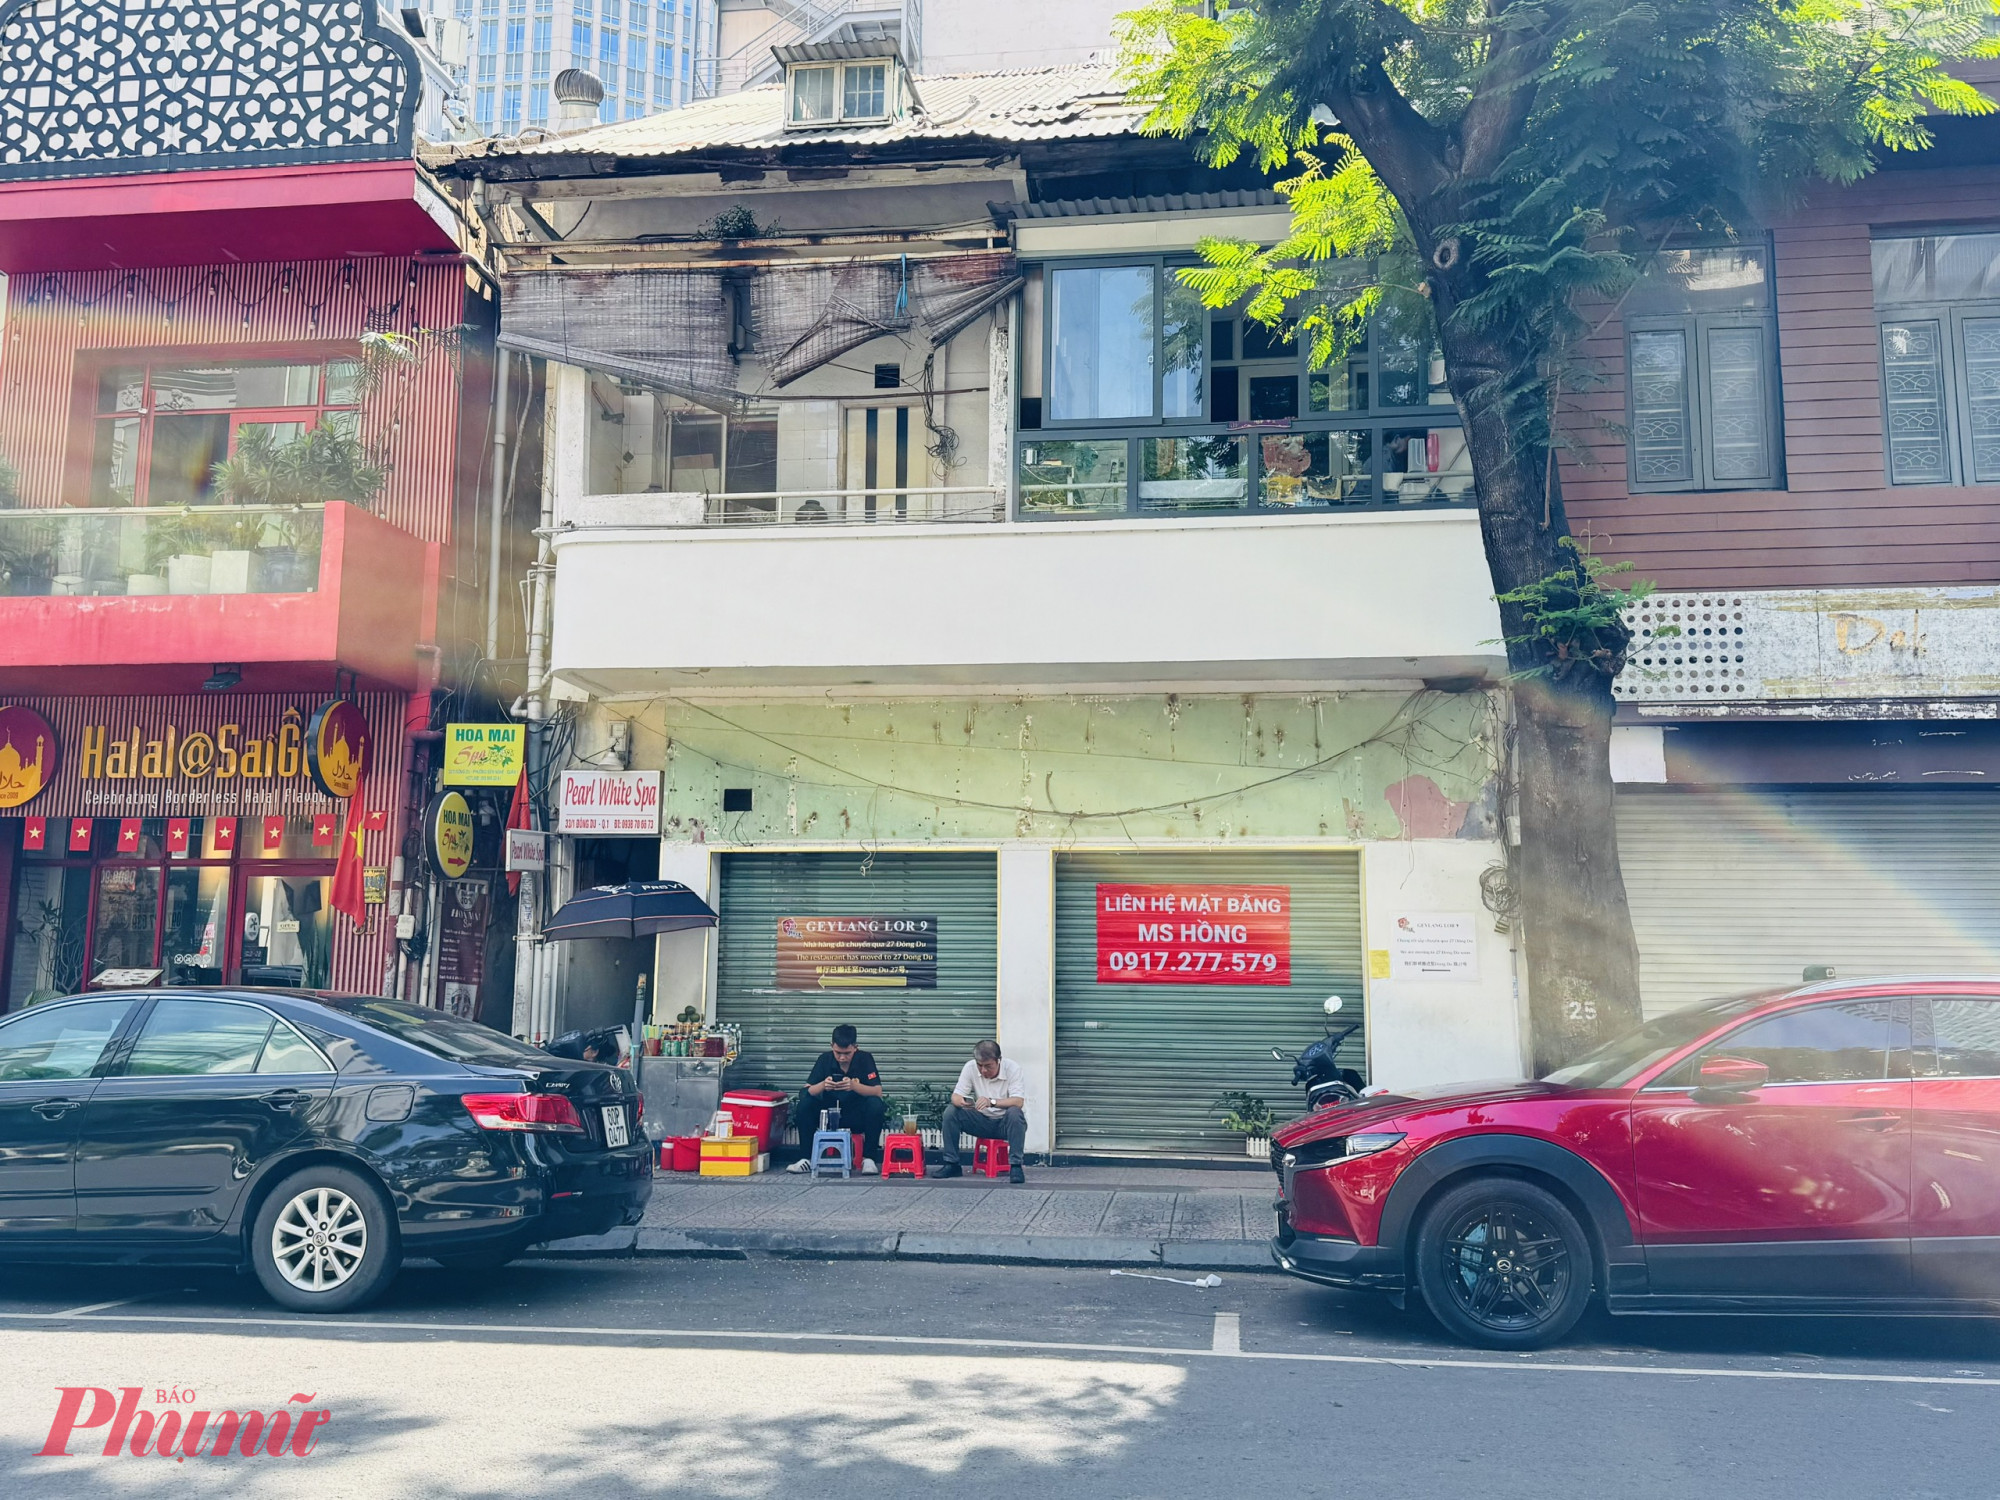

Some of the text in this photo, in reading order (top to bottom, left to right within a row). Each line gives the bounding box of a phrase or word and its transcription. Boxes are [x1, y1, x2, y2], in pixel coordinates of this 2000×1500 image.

[456, 729, 515, 742] HOA MAI
[453, 745, 486, 766] Spa
[85, 789, 158, 809] Celebrating
[165, 788, 237, 804] Borderless
[244, 787, 278, 804] Halal
[564, 777, 657, 812] Pearl White Spa
[443, 809, 470, 827] HOA MAI
[1105, 893, 1281, 916] LIÊN HỆ MẶT BẰNG
[805, 920, 928, 933] GEYLANG LOR 9
[1138, 919, 1248, 944] MS HỒNG
[871, 942, 885, 950] qua
[1109, 951, 1278, 973] 0917.277.579
[1569, 1001, 1598, 1020] 25
[608, 1125, 625, 1145] 0477
